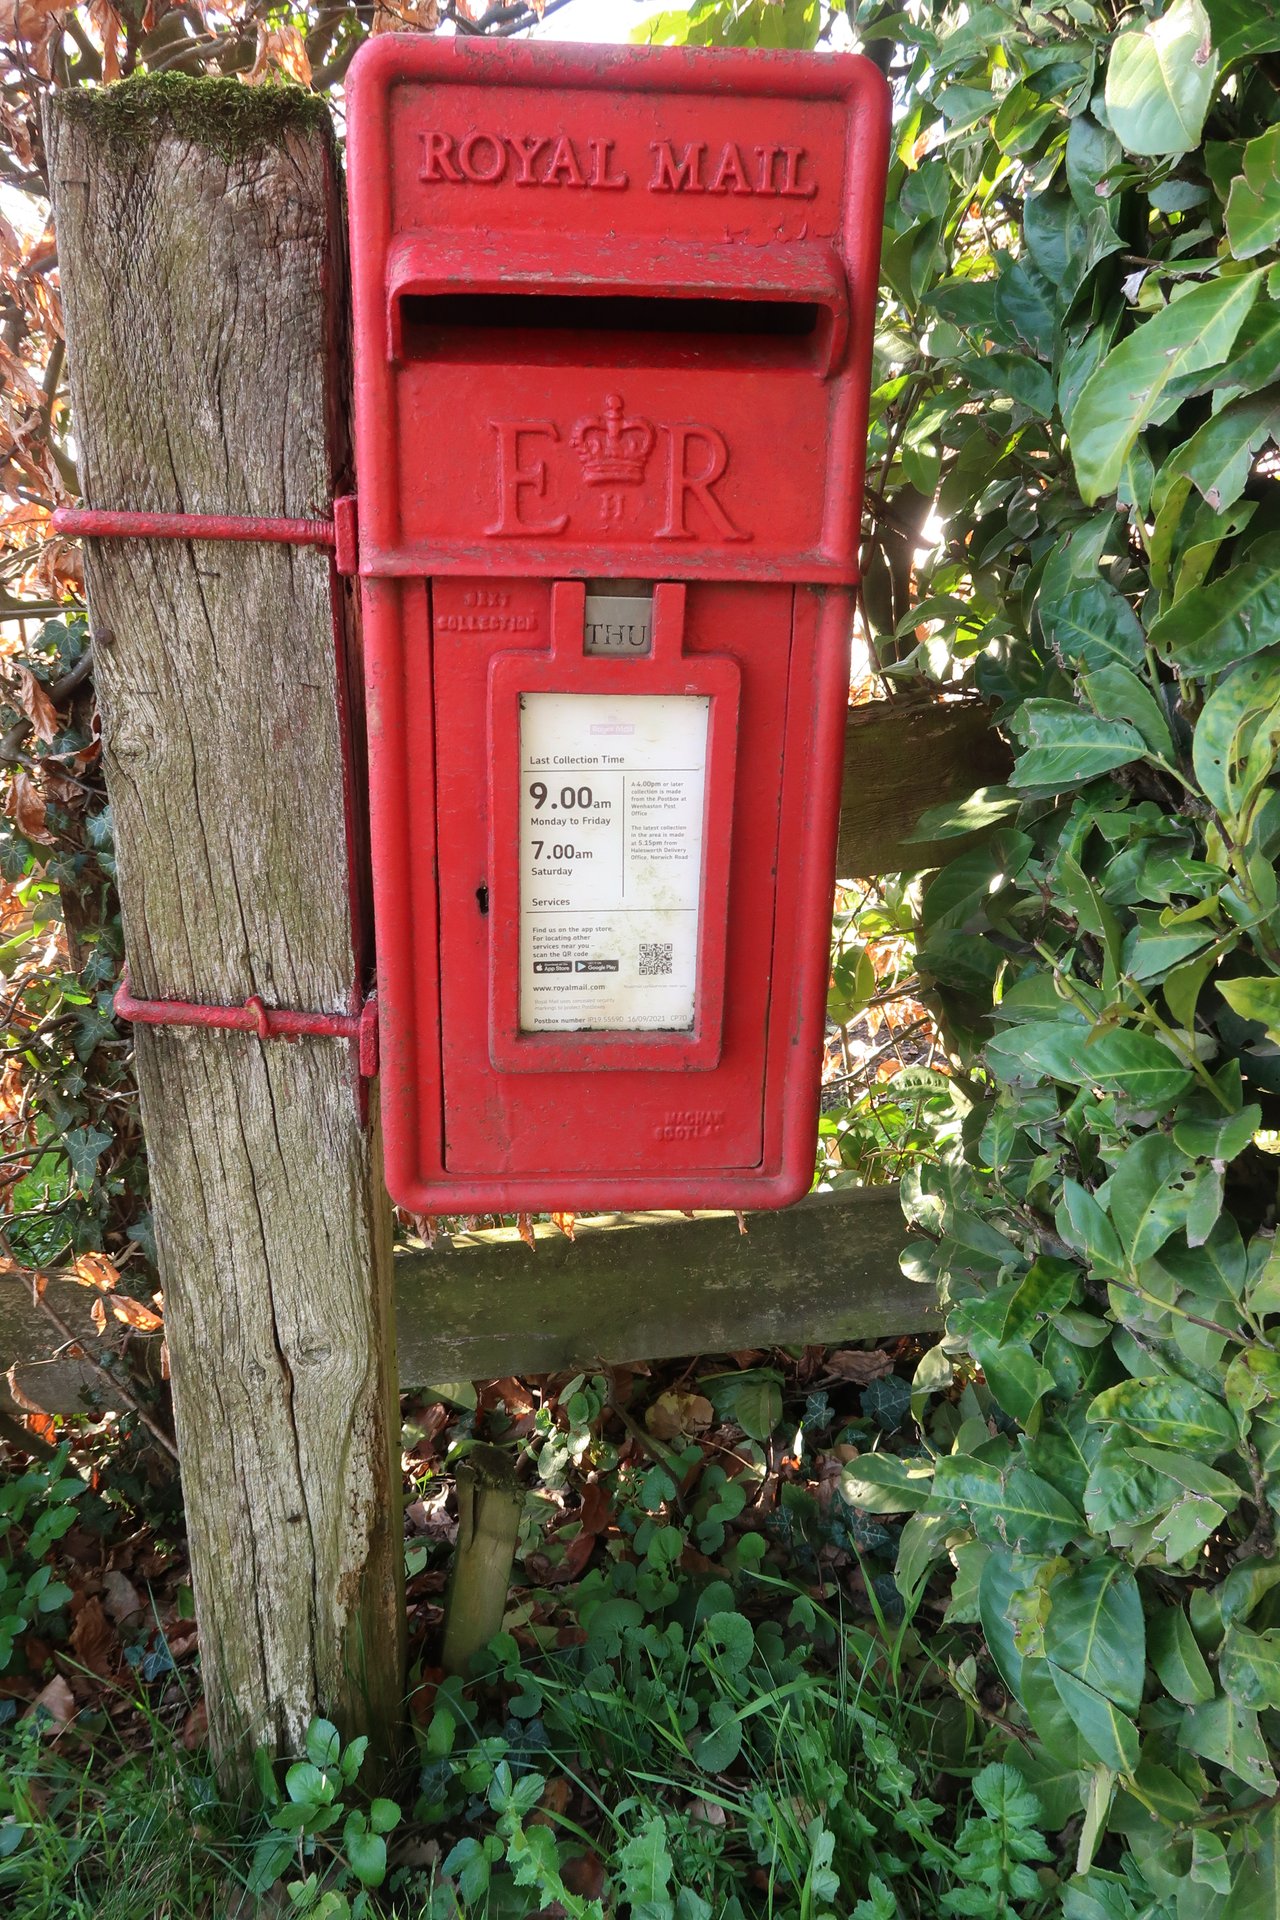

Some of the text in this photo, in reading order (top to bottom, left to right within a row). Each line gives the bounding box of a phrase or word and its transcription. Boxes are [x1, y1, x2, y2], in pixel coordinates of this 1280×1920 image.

[418, 130, 819, 198] ROYAL MAIL
[483, 417, 754, 543] E R
[437, 615, 540, 633] COLLECTION
[586, 623, 648, 646] THU
[529, 754, 625, 765] Last Collection Time
[529, 782, 612, 810] 9.00am
[531, 818, 567, 827] Monday
[582, 817, 611, 826] Friday
[531, 841, 593, 860] 7.00am
[531, 868, 573, 876] Saturday
[532, 898, 571, 906] Services
[545, 935, 571, 943] locating
[533, 984, 606, 992] www.royalmail.com
[628, 1015, 666, 1023] 16/09/2021
